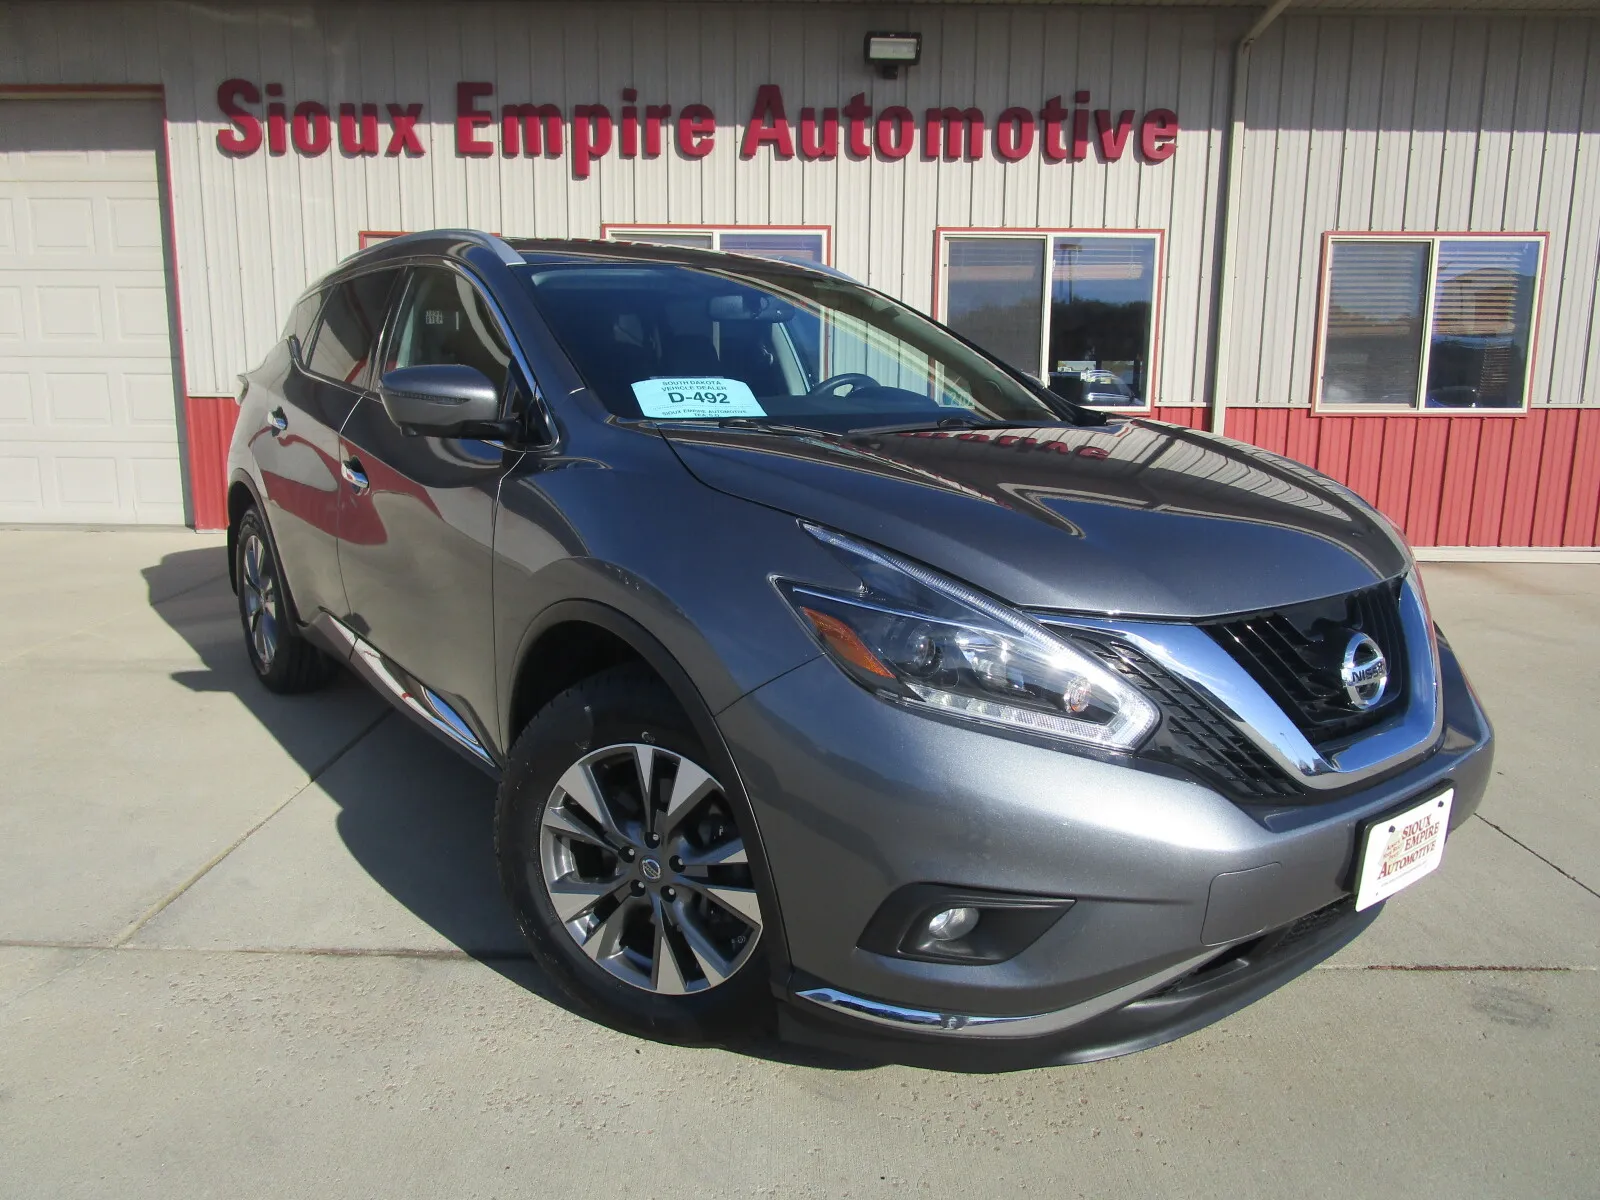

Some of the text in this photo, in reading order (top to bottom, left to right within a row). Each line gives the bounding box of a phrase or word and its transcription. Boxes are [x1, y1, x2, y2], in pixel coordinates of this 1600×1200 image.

[217, 79, 1179, 178] Sioux Empire Automotive
[668, 392, 730, 403] D-492
[1402, 814, 1432, 840] SIOUX
[1404, 822, 1440, 851] EMPIRE
[1377, 840, 1437, 880] AUTOMOTIVE
